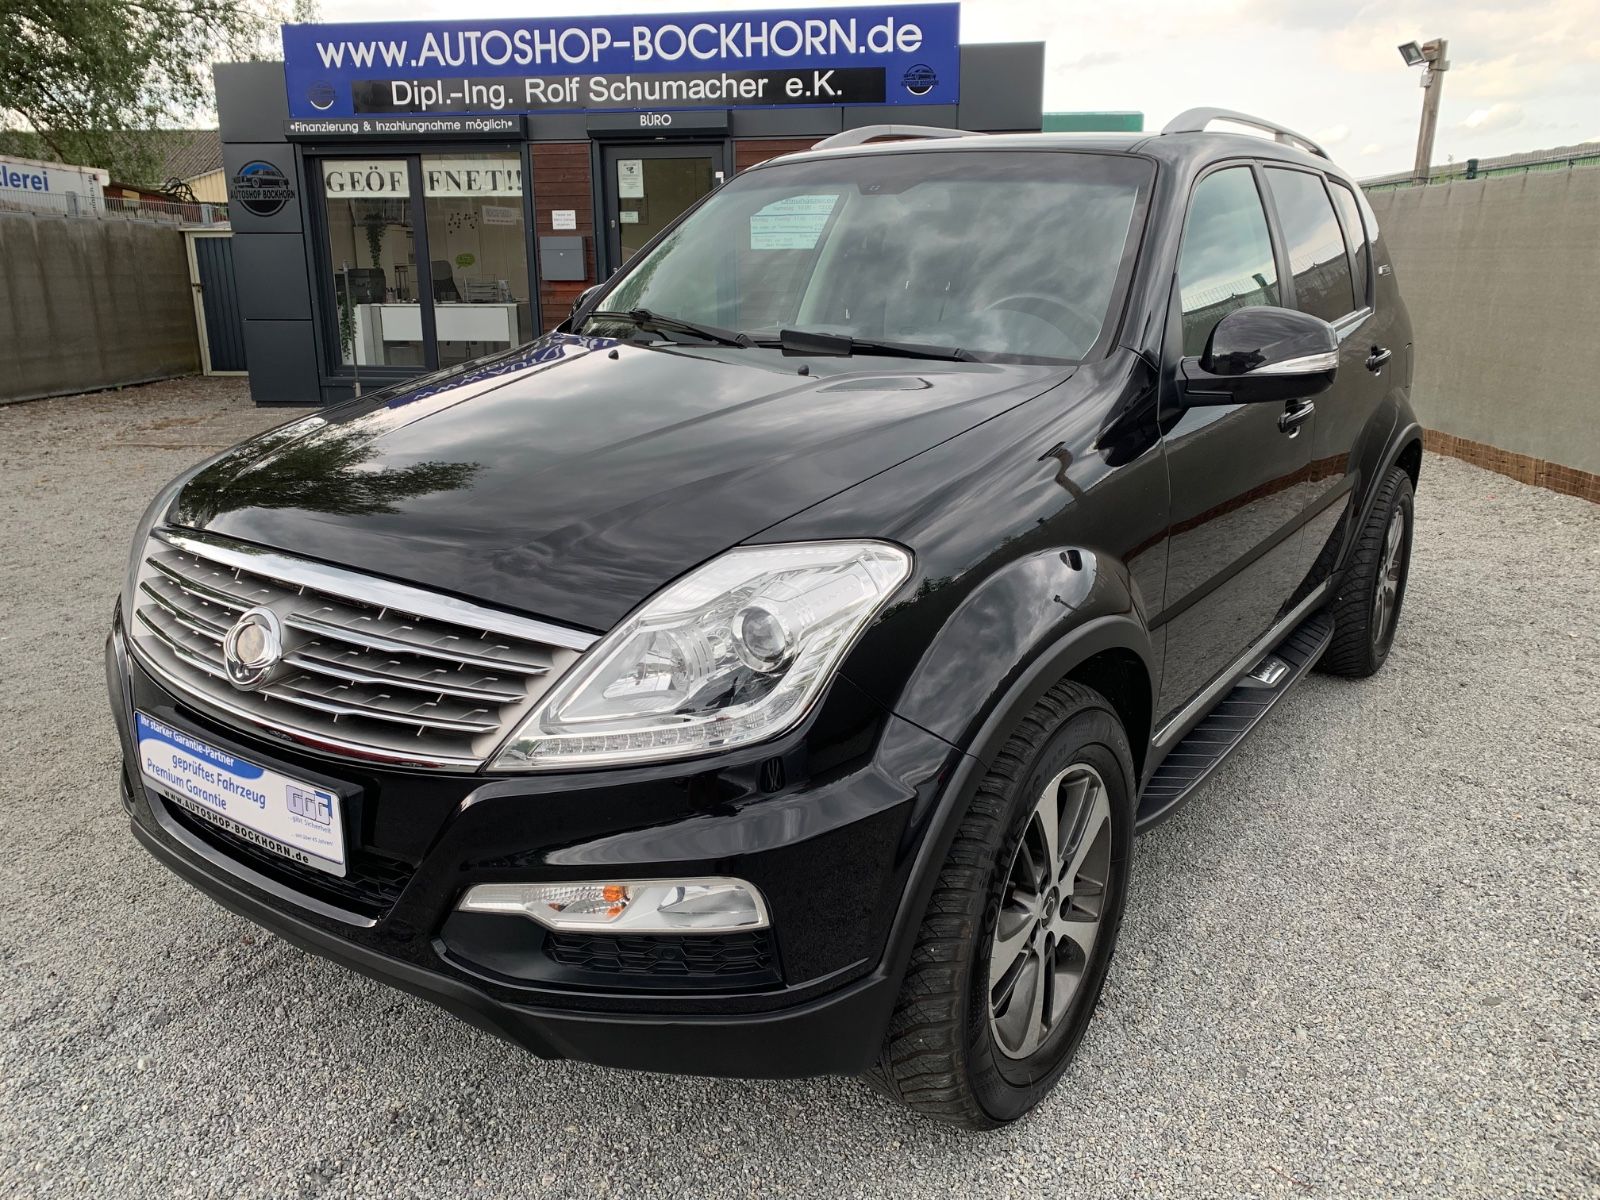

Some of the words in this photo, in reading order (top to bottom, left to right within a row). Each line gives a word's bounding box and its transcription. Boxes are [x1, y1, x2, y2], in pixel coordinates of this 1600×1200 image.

[316, 17, 923, 68] www.AUTOSHOP-BOCKHORN.de
[391, 79, 513, 111] Dipl.-Ing.
[526, 77, 580, 103] Rolf
[588, 72, 768, 102] Schumacher
[785, 70, 843, 98] e.K.
[363, 121, 371, 131] &
[376, 120, 461, 133] Inzahlungnahme
[639, 112, 672, 127] BÜRO
[0, 165, 49, 192] lerei
[230, 189, 261, 200] AUTOSHOP
[262, 189, 296, 199] BOCKHORN
[141, 714, 150, 727] Ihr
[150, 720, 173, 738] starker
[173, 731, 235, 767] Garantie-Partner
[147, 758, 185, 788] Premium
[186, 779, 227, 810] Garantie
[172, 754, 215, 784] geprüftes
[217, 773, 266, 810] Fahrzeug
